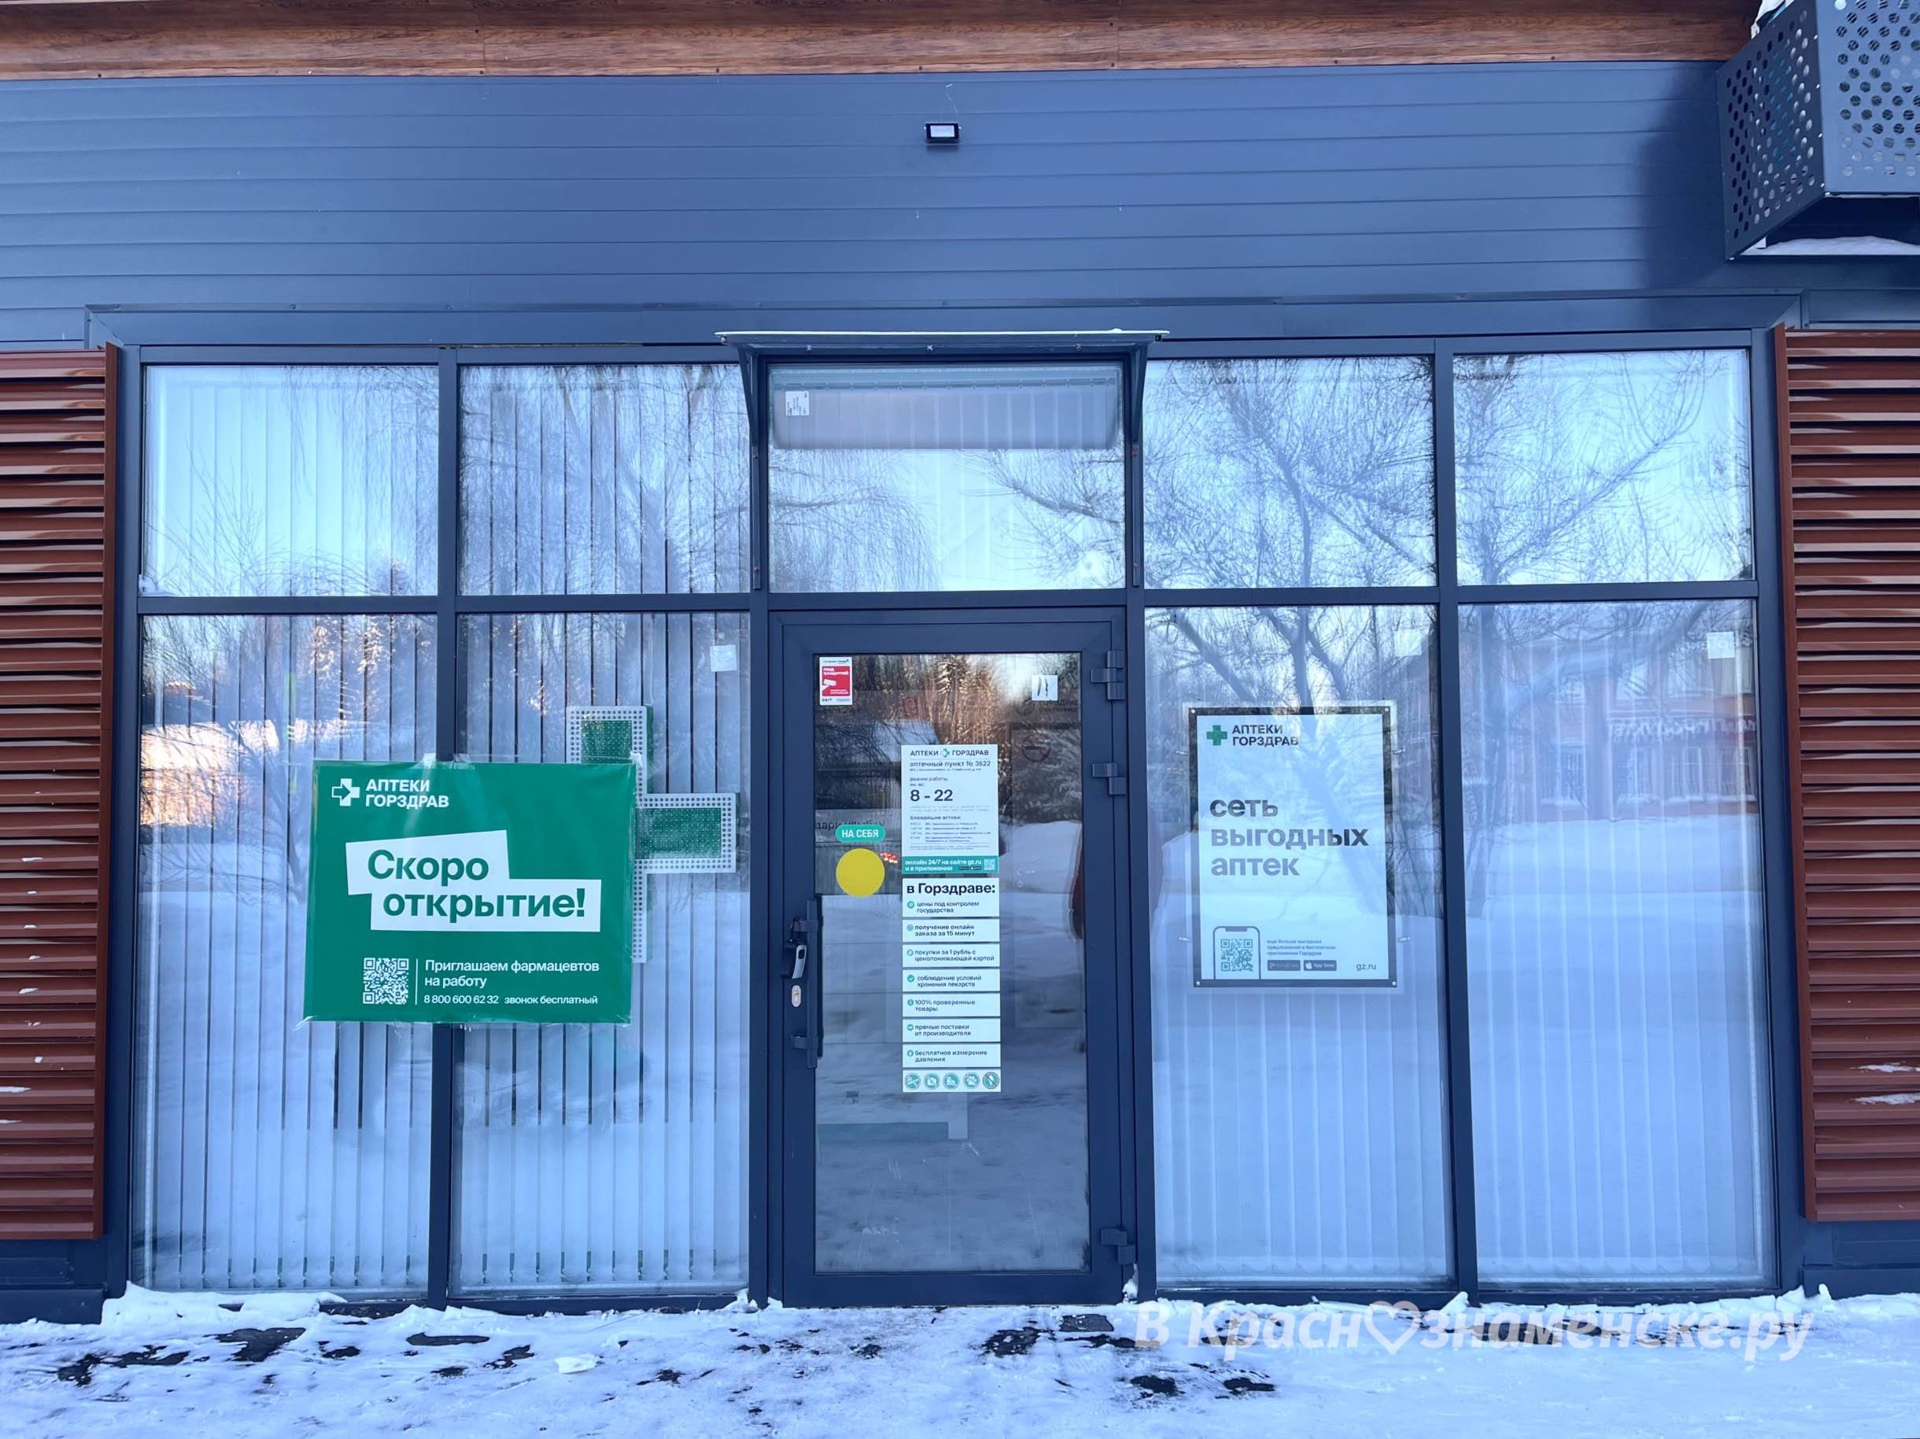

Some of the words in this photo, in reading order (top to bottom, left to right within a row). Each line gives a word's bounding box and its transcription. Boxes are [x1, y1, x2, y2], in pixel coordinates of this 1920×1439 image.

[1232, 724, 1283, 735] АПТЕКИ
[1232, 736, 1299, 748] ГОРЗДРАВ
[365, 778, 430, 793] АПТЕКИ
[365, 794, 449, 810] ГОРЗДРАВ
[910, 789, 920, 802] 8
[934, 789, 953, 802] 22
[1210, 799, 1279, 818] сеть
[841, 829, 855, 838] НА
[856, 829, 879, 838] СЕБЯ
[1211, 828, 1369, 850] выгодных
[367, 849, 489, 887] Скоро
[1211, 857, 1300, 876] аптек
[907, 885, 915, 894] в
[918, 883, 996, 896] Горздраве:
[383, 888, 586, 924] открытие!
[425, 959, 508, 973] Приглашаем
[510, 960, 600, 974] фармацевтов
[1356, 963, 1376, 972] gz.ru
[424, 977, 440, 987] на
[442, 975, 487, 988] работу
[423, 994, 430, 1004] 8
[431, 995, 451, 1004] 800
[452, 995, 472, 1004] 600
[473, 995, 486, 1004] 62
[486, 995, 499, 1004] 32
[504, 996, 538, 1004] звонок
[540, 995, 598, 1005] бесплатный
